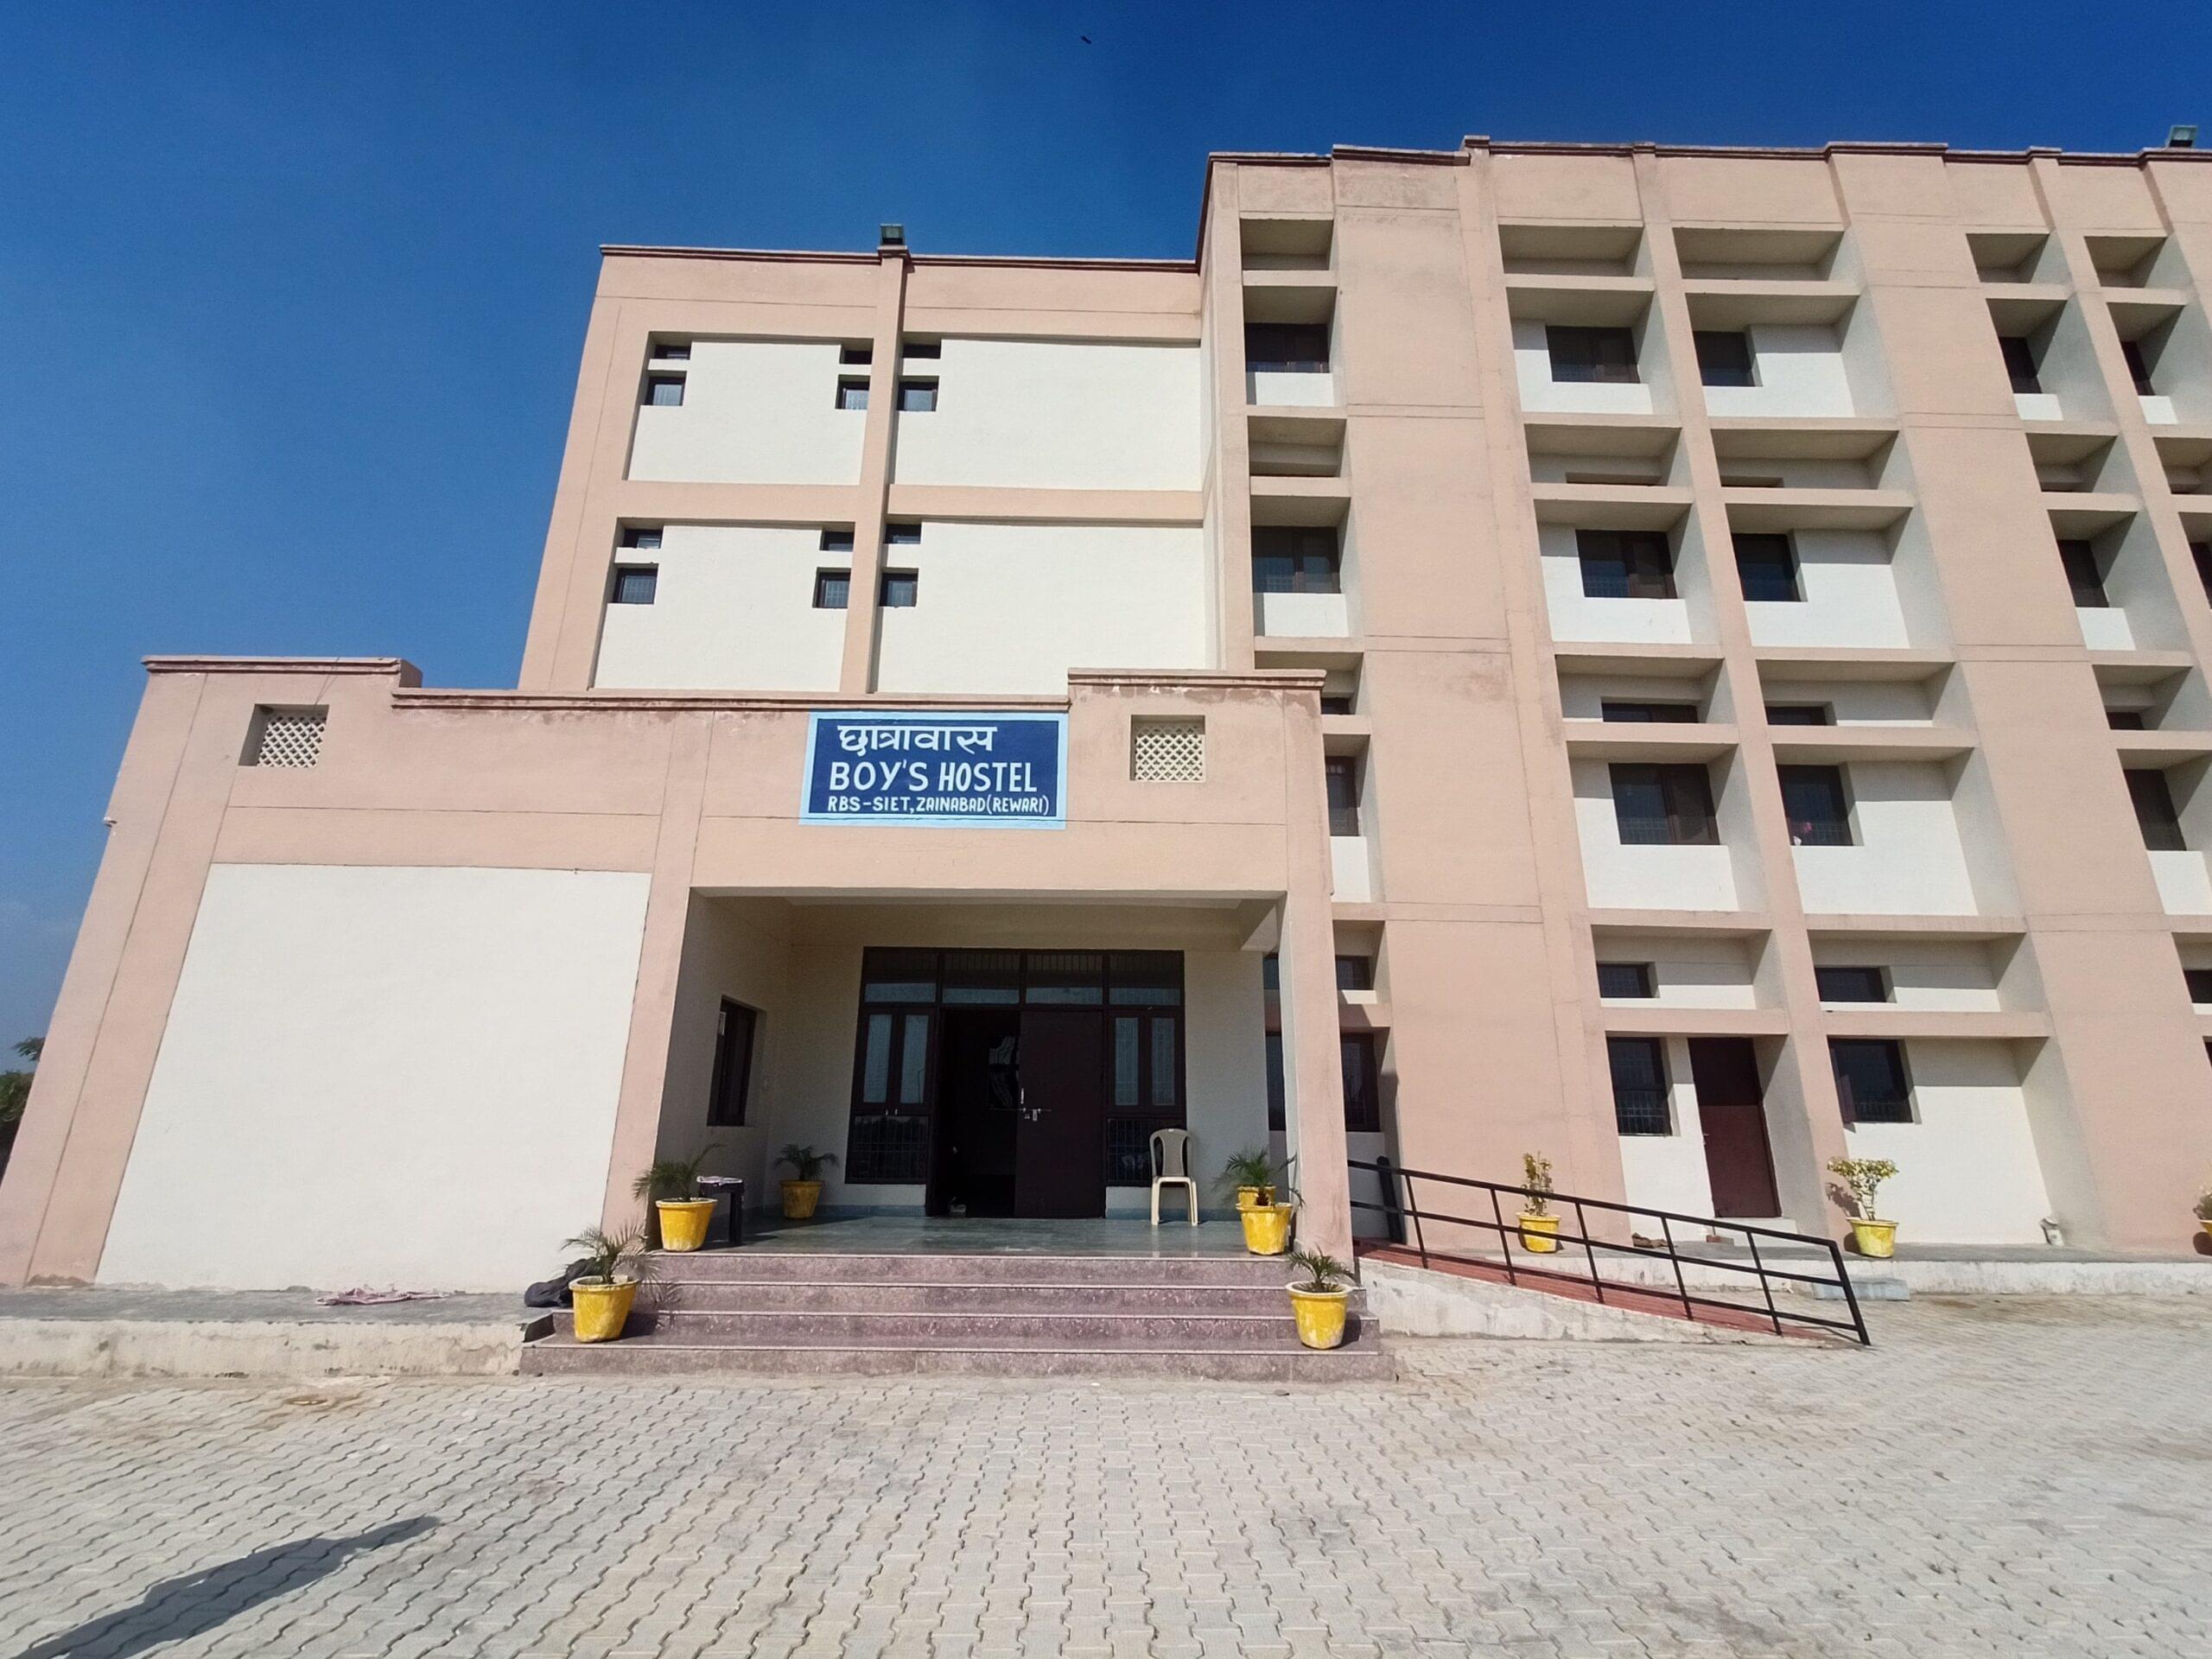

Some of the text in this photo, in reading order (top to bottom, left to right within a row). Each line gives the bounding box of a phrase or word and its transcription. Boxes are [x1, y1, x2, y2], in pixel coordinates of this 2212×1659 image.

[836, 725, 998, 757] छात्रावास
[829, 759, 1038, 792] BOY'S HOSTEL
